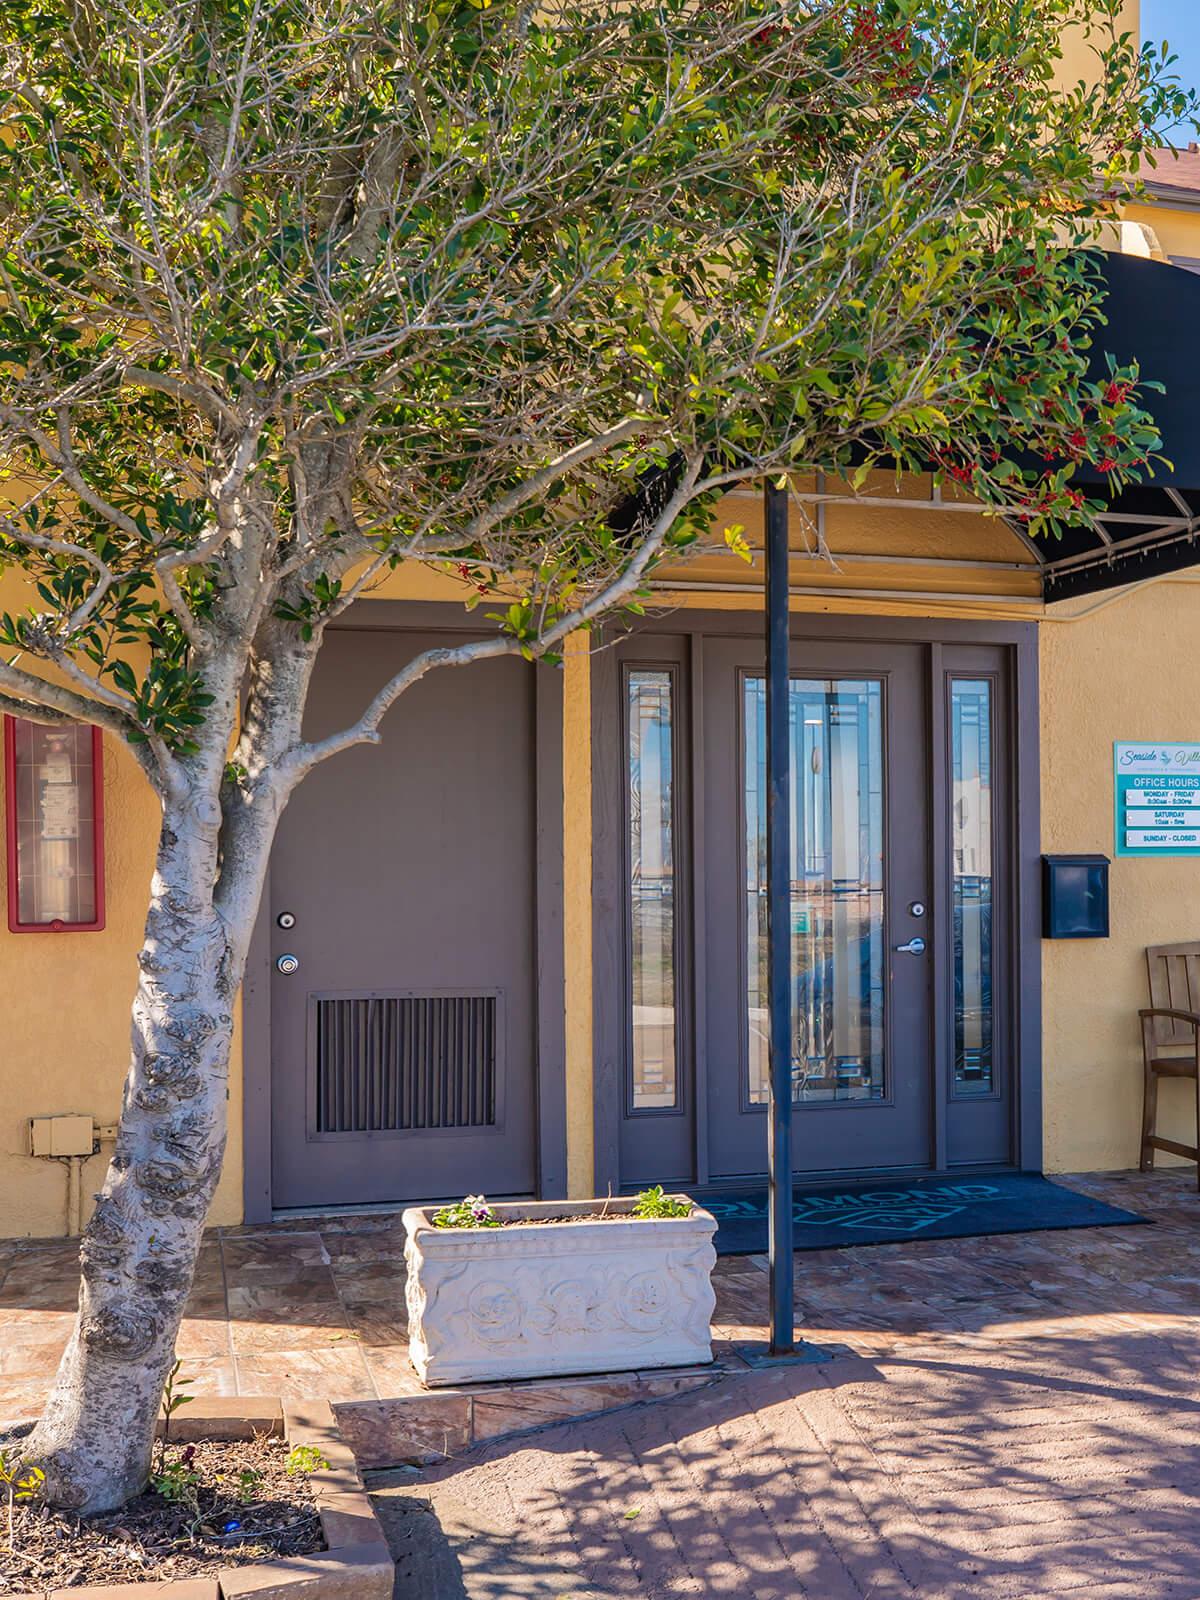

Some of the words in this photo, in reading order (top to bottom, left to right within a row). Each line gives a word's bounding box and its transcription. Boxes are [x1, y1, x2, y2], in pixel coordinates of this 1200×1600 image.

[1120, 750, 1157, 765] Seaside
[1134, 778, 1165, 787] OFFICE
[1169, 778, 1199, 786] HOURS
